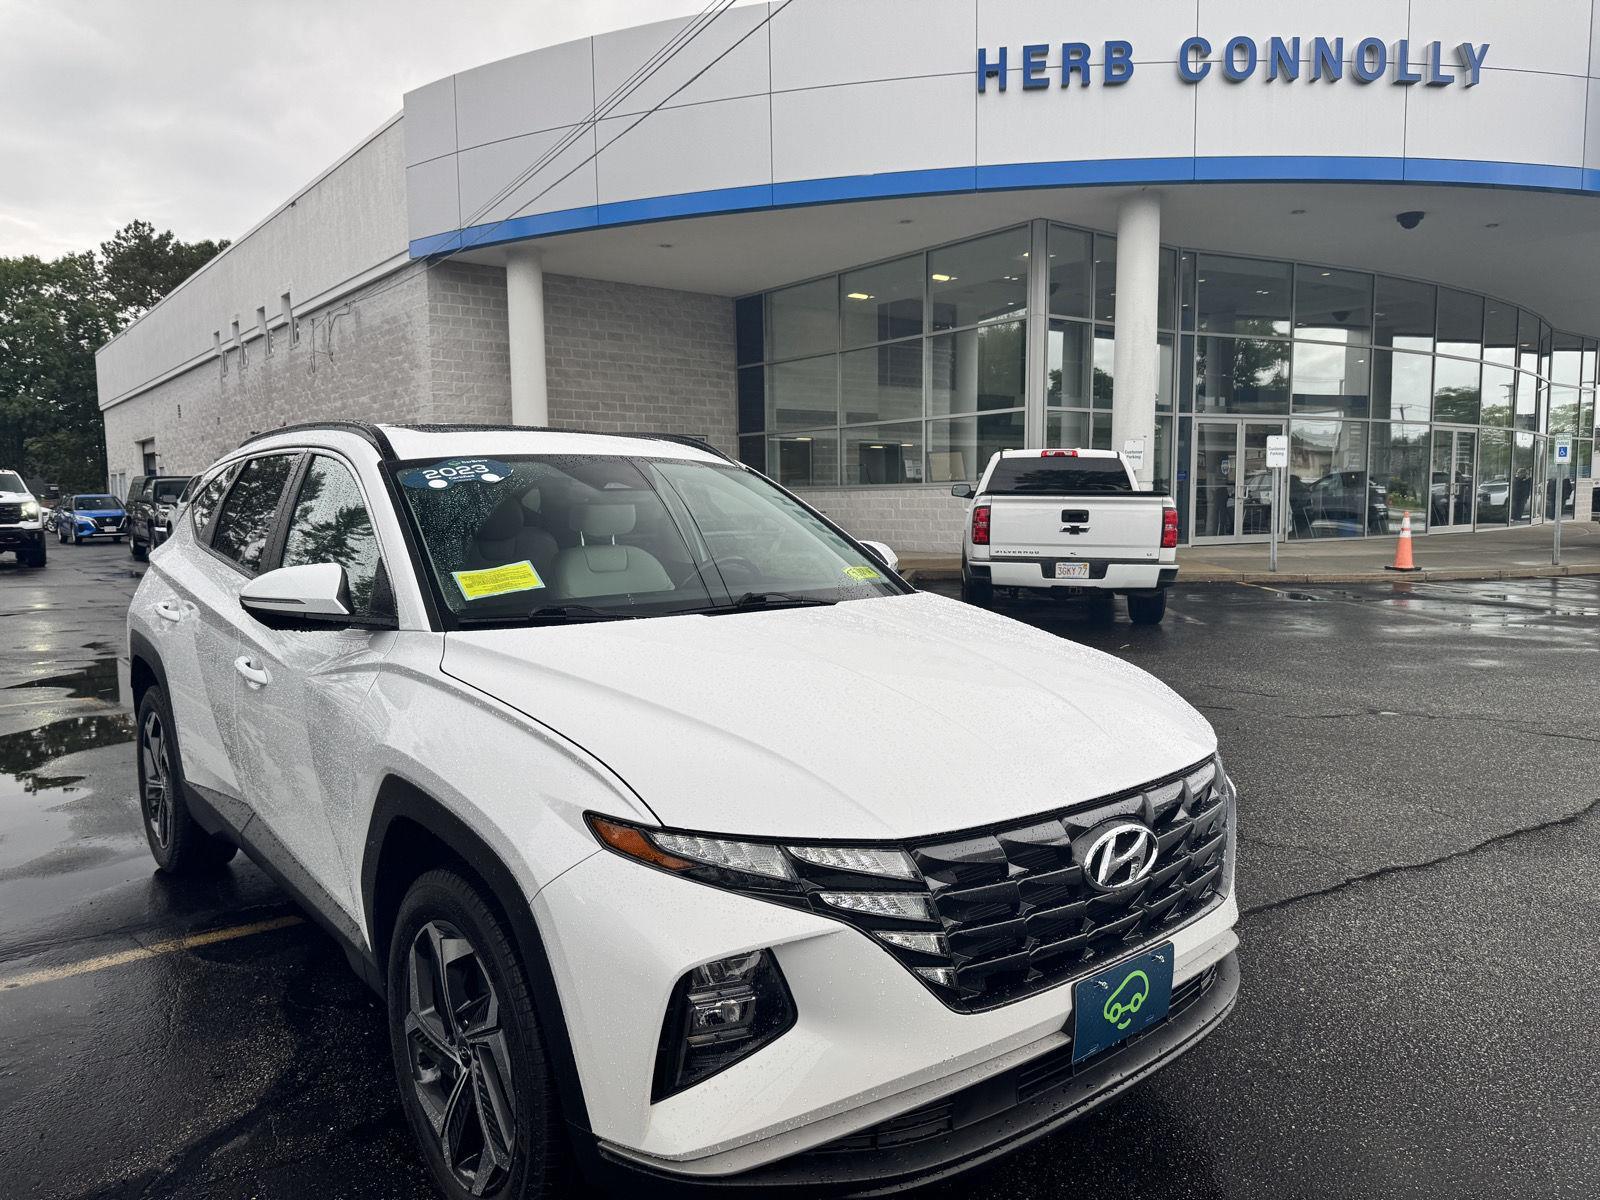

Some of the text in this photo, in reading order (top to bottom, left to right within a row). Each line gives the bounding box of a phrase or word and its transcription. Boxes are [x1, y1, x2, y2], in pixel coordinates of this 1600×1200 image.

[978, 35, 1490, 93] HERB CONNOLLY
[422, 464, 489, 479] 2023
